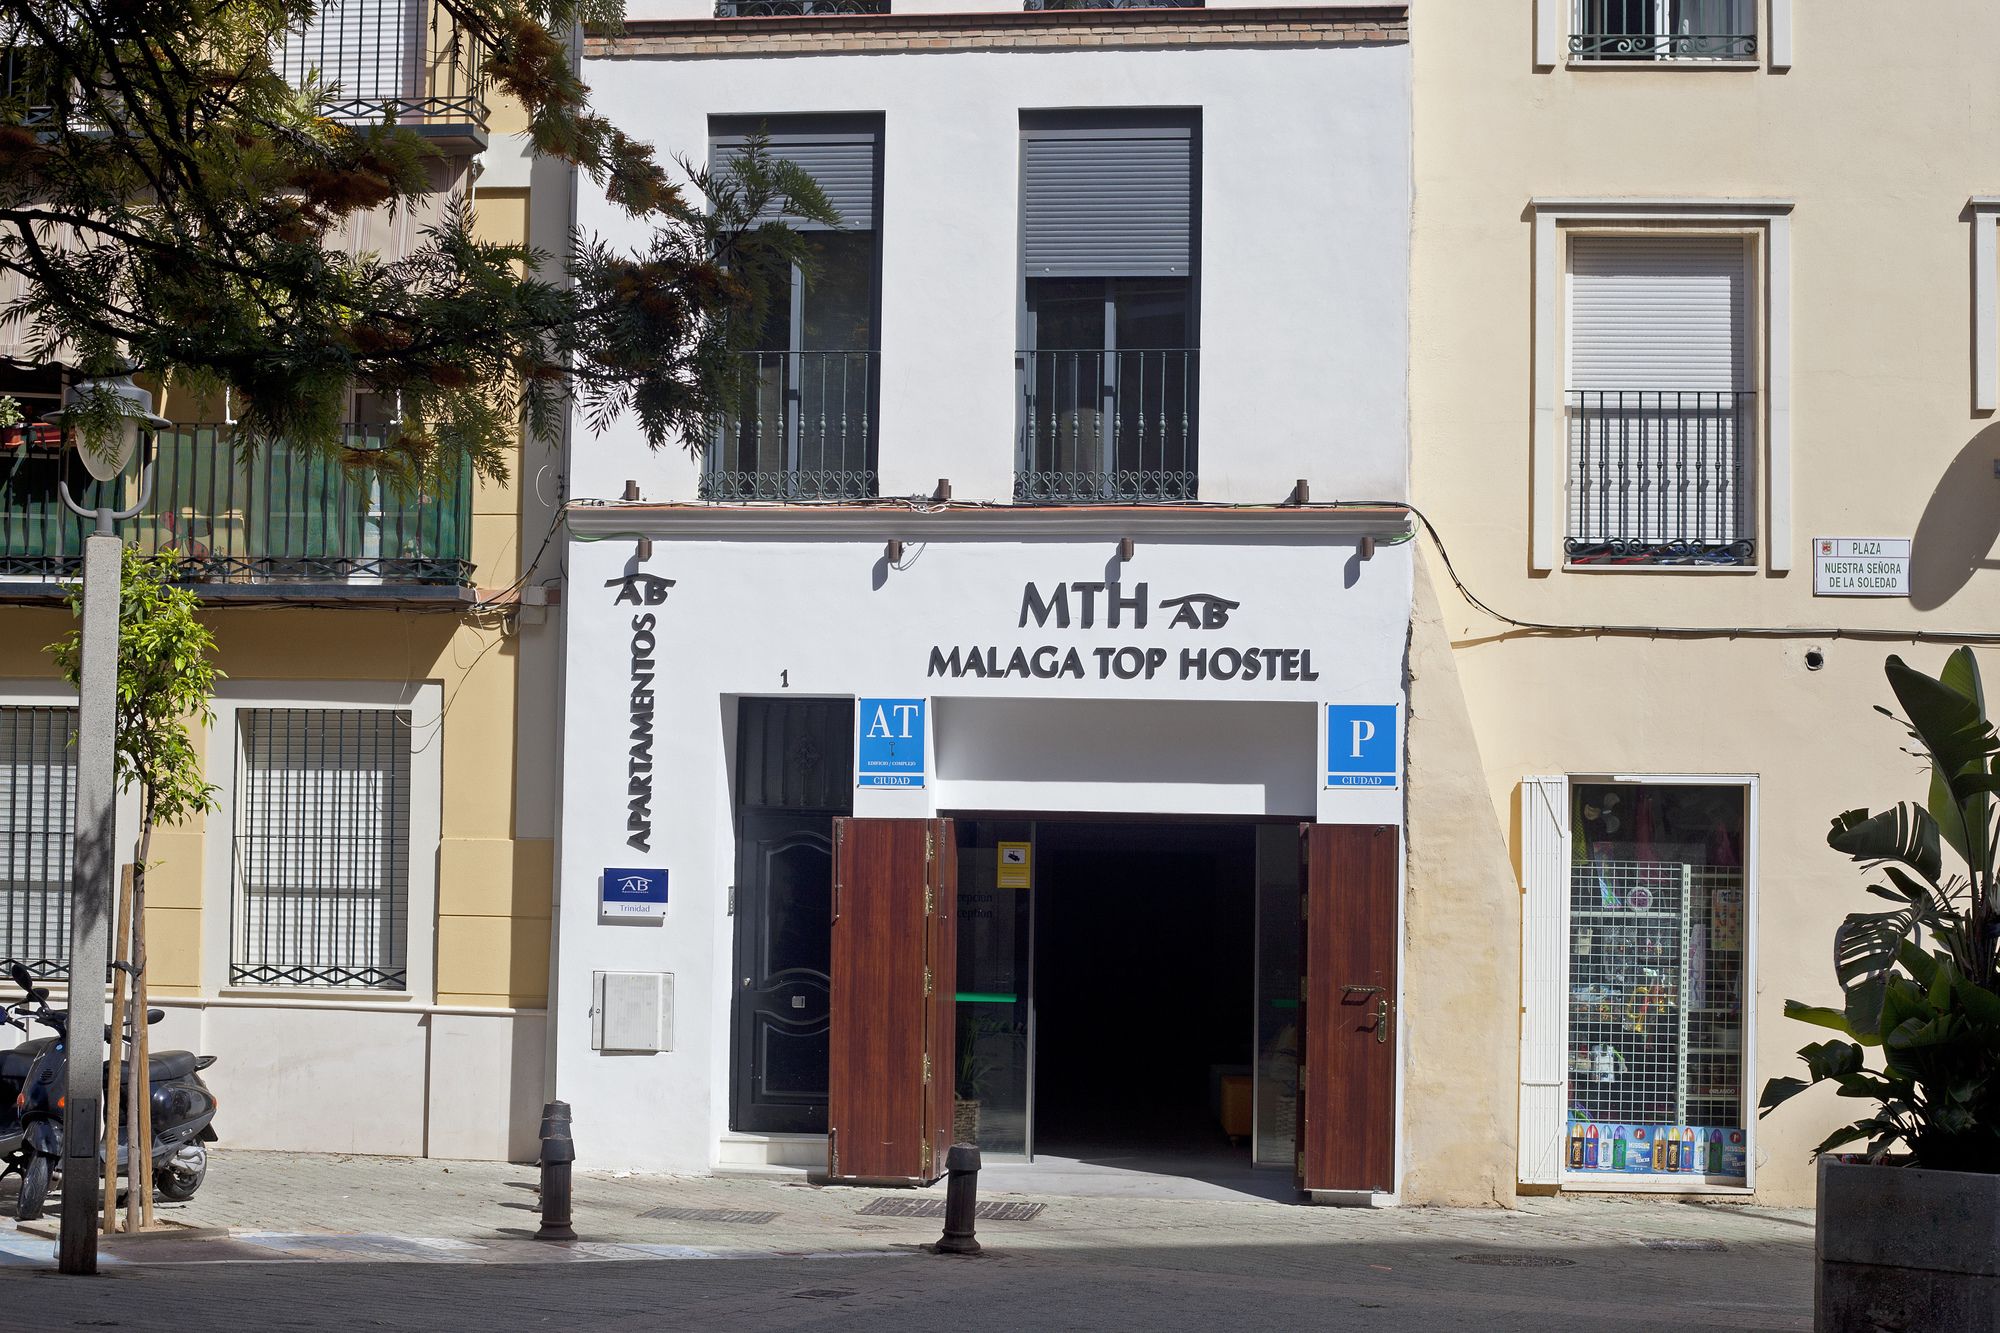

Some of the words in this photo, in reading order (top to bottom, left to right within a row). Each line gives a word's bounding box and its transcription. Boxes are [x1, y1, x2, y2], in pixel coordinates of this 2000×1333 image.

[1852, 542, 1881, 555] PLAZA
[1824, 562, 1864, 574] NUESTRA
[1866, 561, 1902, 574] SEÑORA
[608, 574, 672, 606] AB
[1829, 576, 1841, 588] DE
[1843, 577, 1855, 588] LA
[1857, 577, 1897, 588] SOLEDAD
[1018, 582, 1148, 630] MTH
[1163, 594, 1236, 630] AB
[927, 645, 1085, 679] MALAGA
[1092, 646, 1167, 680] TOP
[1179, 647, 1319, 682] HOSTEL
[780, 669, 789, 688] 1
[866, 704, 918, 738] AT
[626, 612, 656, 854] APARTAMENTOS
[1349, 719, 1375, 758] P
[873, 776, 910, 785] CIUDAD
[1341, 776, 1383, 785] CIUDAD
[619, 877, 650, 891] AB
[620, 904, 651, 913] Trinidad
